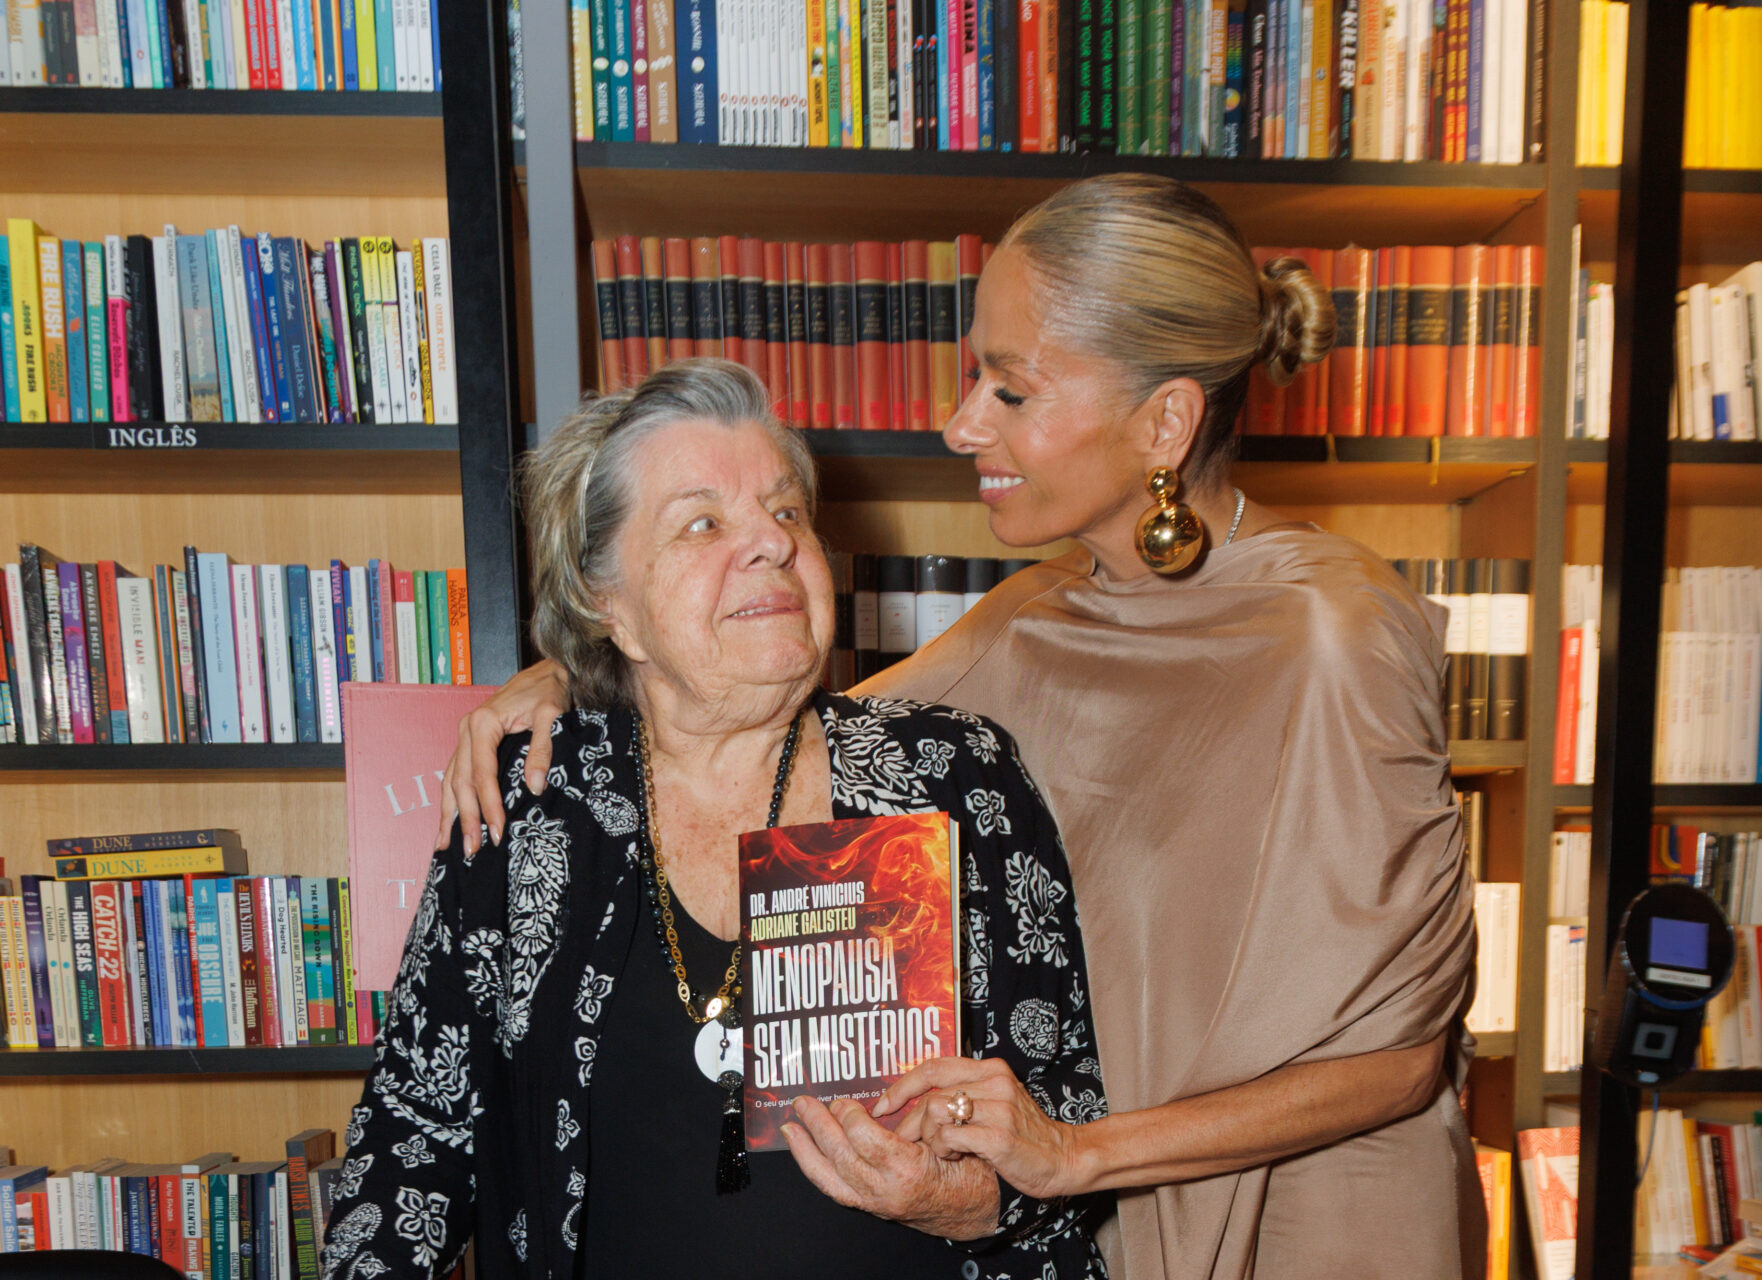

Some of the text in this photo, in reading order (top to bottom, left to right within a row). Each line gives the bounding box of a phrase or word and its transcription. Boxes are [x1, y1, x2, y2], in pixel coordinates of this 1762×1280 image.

[1211, 9, 1224, 83] CHILEAN POET
[1340, 10, 1357, 88] KILLER
[1080, 25, 1091, 126] YOUR WAY HOME
[1101, 29, 1112, 129] YOUR WAY HOME
[40, 241, 63, 338] FIRE RUSH
[349, 246, 362, 317] PHILIP K. DICK
[111, 302, 121, 344] Reservoir
[231, 229, 256, 404] AFTERMATH RACHEL CUSK
[414, 243, 431, 400] SALVADOR JOAN DIDION
[431, 244, 446, 371] CELIA DALE OTHER PEOPLE
[25, 344, 36, 392] FIRE RUSH
[56, 343, 65, 398] JACQUELINE
[173, 350, 182, 383] RACHEL
[292, 344, 305, 398] Daniel Defoe
[394, 348, 402, 370] DICK
[108, 424, 198, 447] INGLÊS
[43, 568, 62, 643] AKWAEKE EMEZI
[61, 588, 71, 614] Emezi
[69, 581, 80, 620] Akwaeke
[331, 565, 341, 604] VIVIAN
[448, 579, 458, 626] HAWKINS
[458, 587, 466, 618] PAULA
[84, 571, 100, 659] AKWAEKE EMEZI
[129, 585, 145, 664] INVISIBLE MAN
[316, 576, 334, 726] WILLIAM GIBSON NEUROMANCER
[456, 638, 465, 673] SLOW FIRE
[81, 707, 89, 727] Death
[384, 769, 445, 817] LI
[92, 836, 132, 849] DUNE
[92, 859, 147, 876] DUNE
[44, 906, 55, 941] Orlanda
[750, 881, 865, 918] DR. ANDRÉ VINÍCIUS
[0, 926, 10, 961] FIDELITY
[57, 907, 68, 943] Orlanda
[73, 896, 92, 972] THE HIGH SEAS
[93, 895, 119, 980] CATCH-22
[187, 896, 198, 961] PARIS IN TURMOIL
[197, 922, 218, 937] JUDE
[276, 906, 288, 954] Dog Hearted
[291, 914, 300, 939] POSSESSION
[310, 883, 322, 968] THE RISING DOWN
[343, 929, 351, 939] My
[750, 907, 856, 942] ADRIANE GALISTEU
[14, 926, 25, 961] FIDELITY
[21, 986, 30, 1011] HORNBY
[198, 944, 223, 1003] OBSCURE
[222, 898, 239, 1025] THE COURSE John Harrison
[238, 892, 258, 1028] DEVIL'S ELIXIRS Hoffmann
[344, 940, 352, 966] Daughter
[751, 935, 898, 1016] MENOPAUSA
[80, 979, 89, 1020] HEFFERNAN
[87, 989, 95, 1010] OLIVE
[137, 951, 150, 1023] MICHEL HOUELLEBECQ
[263, 965, 274, 1016] SHEILA HETI
[294, 965, 303, 995] MATT
[296, 997, 306, 1025] HAIG
[753, 1005, 940, 1089] SEM MISTÉRIOS
[755, 1100, 761, 1108] O
[815, 1094, 832, 1104] iver
[833, 1092, 851, 1101] bem
[852, 1090, 869, 1101] após
[871, 1090, 880, 1098] os
[1, 1185, 17, 1251] Soldier Sailo
[129, 1191, 140, 1249] JACKIE KABLER
[186, 1182, 197, 1236] THE TALENTED
[214, 1196, 225, 1242] MORAL FABLES
[230, 1194, 238, 1222] THOUGHTS
[240, 1220, 251, 1240] gaia
[287, 1156, 317, 1273] HARSH TIMES MARIO VARGAS
[231, 1251, 239, 1277] GIACOMO
[241, 1257, 250, 1277] James
